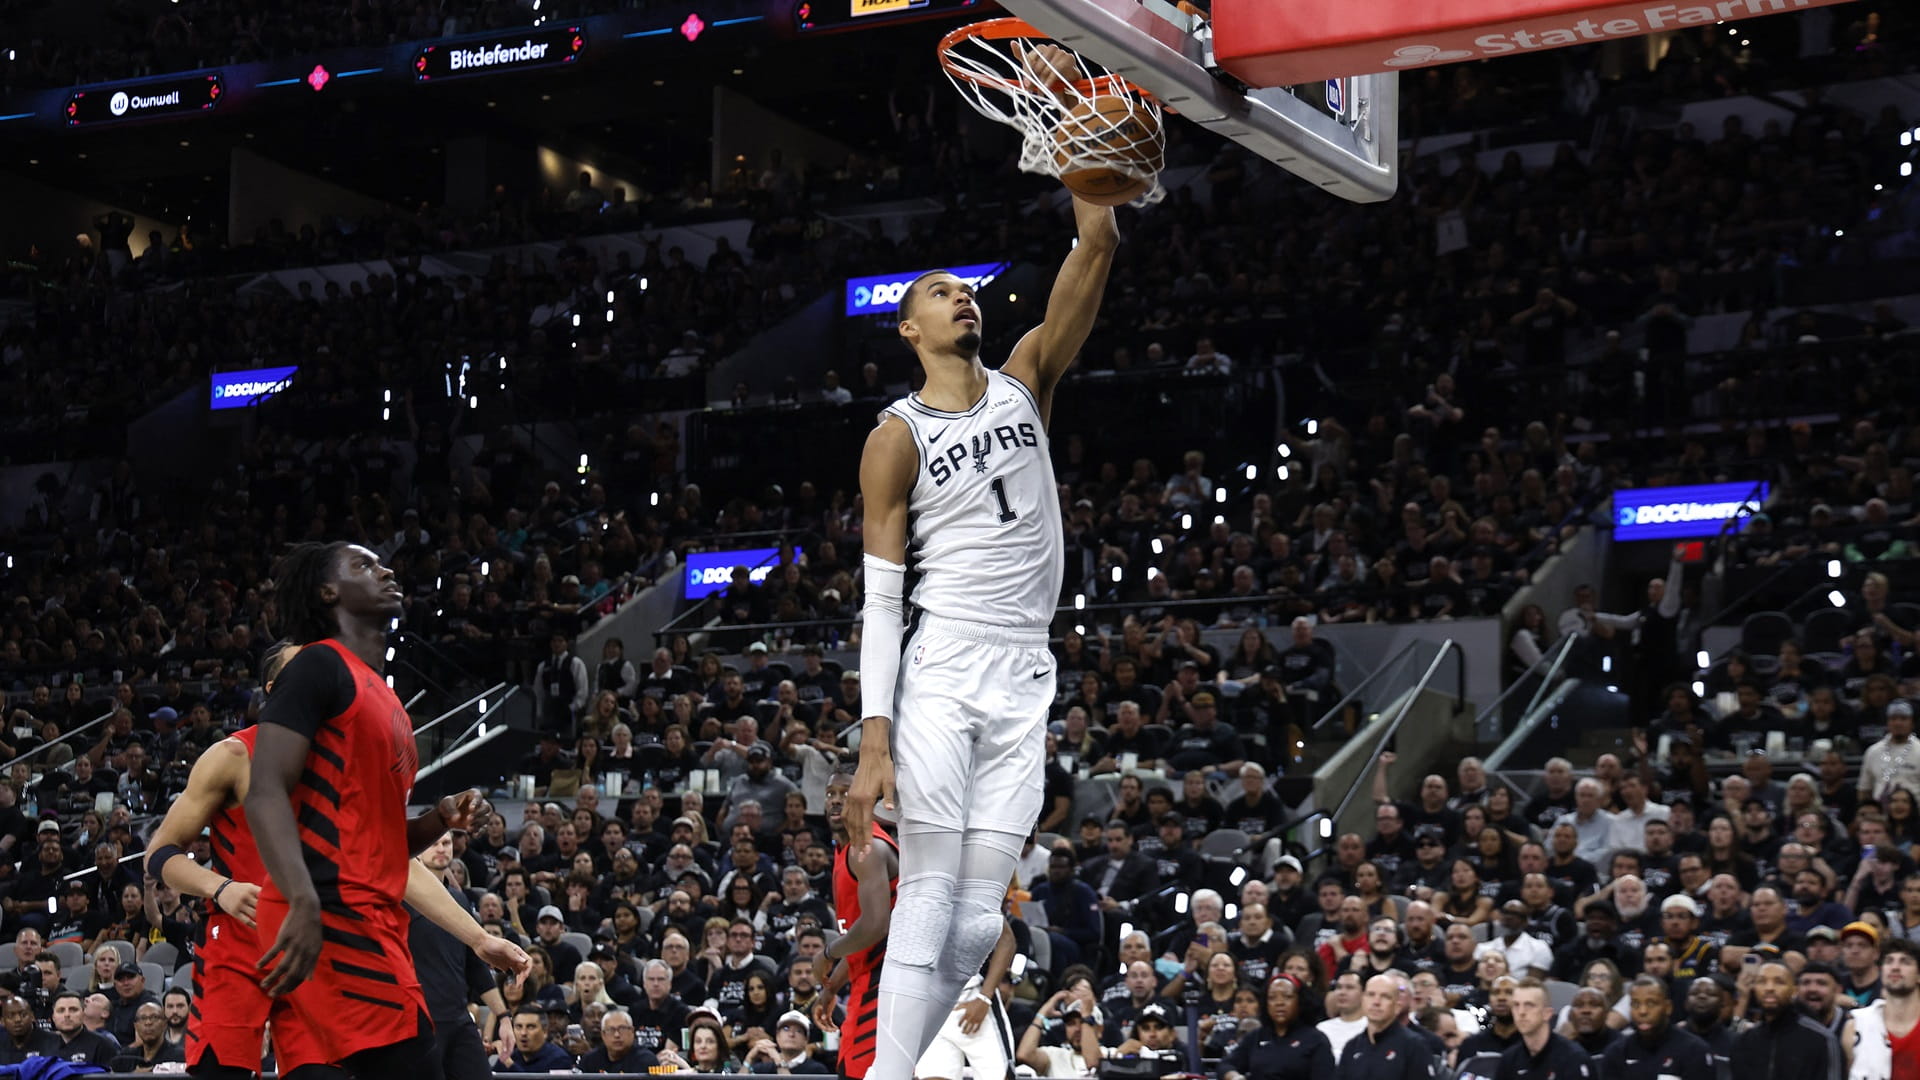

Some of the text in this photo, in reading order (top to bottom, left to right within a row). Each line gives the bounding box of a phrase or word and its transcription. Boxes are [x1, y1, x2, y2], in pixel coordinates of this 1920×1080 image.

[1474, 17, 1641, 54] State
[450, 40, 548, 70] Bitdefender
[131, 91, 179, 109] Ownwell
[929, 423, 1038, 487] SPURS
[991, 476, 1019, 524] 1
